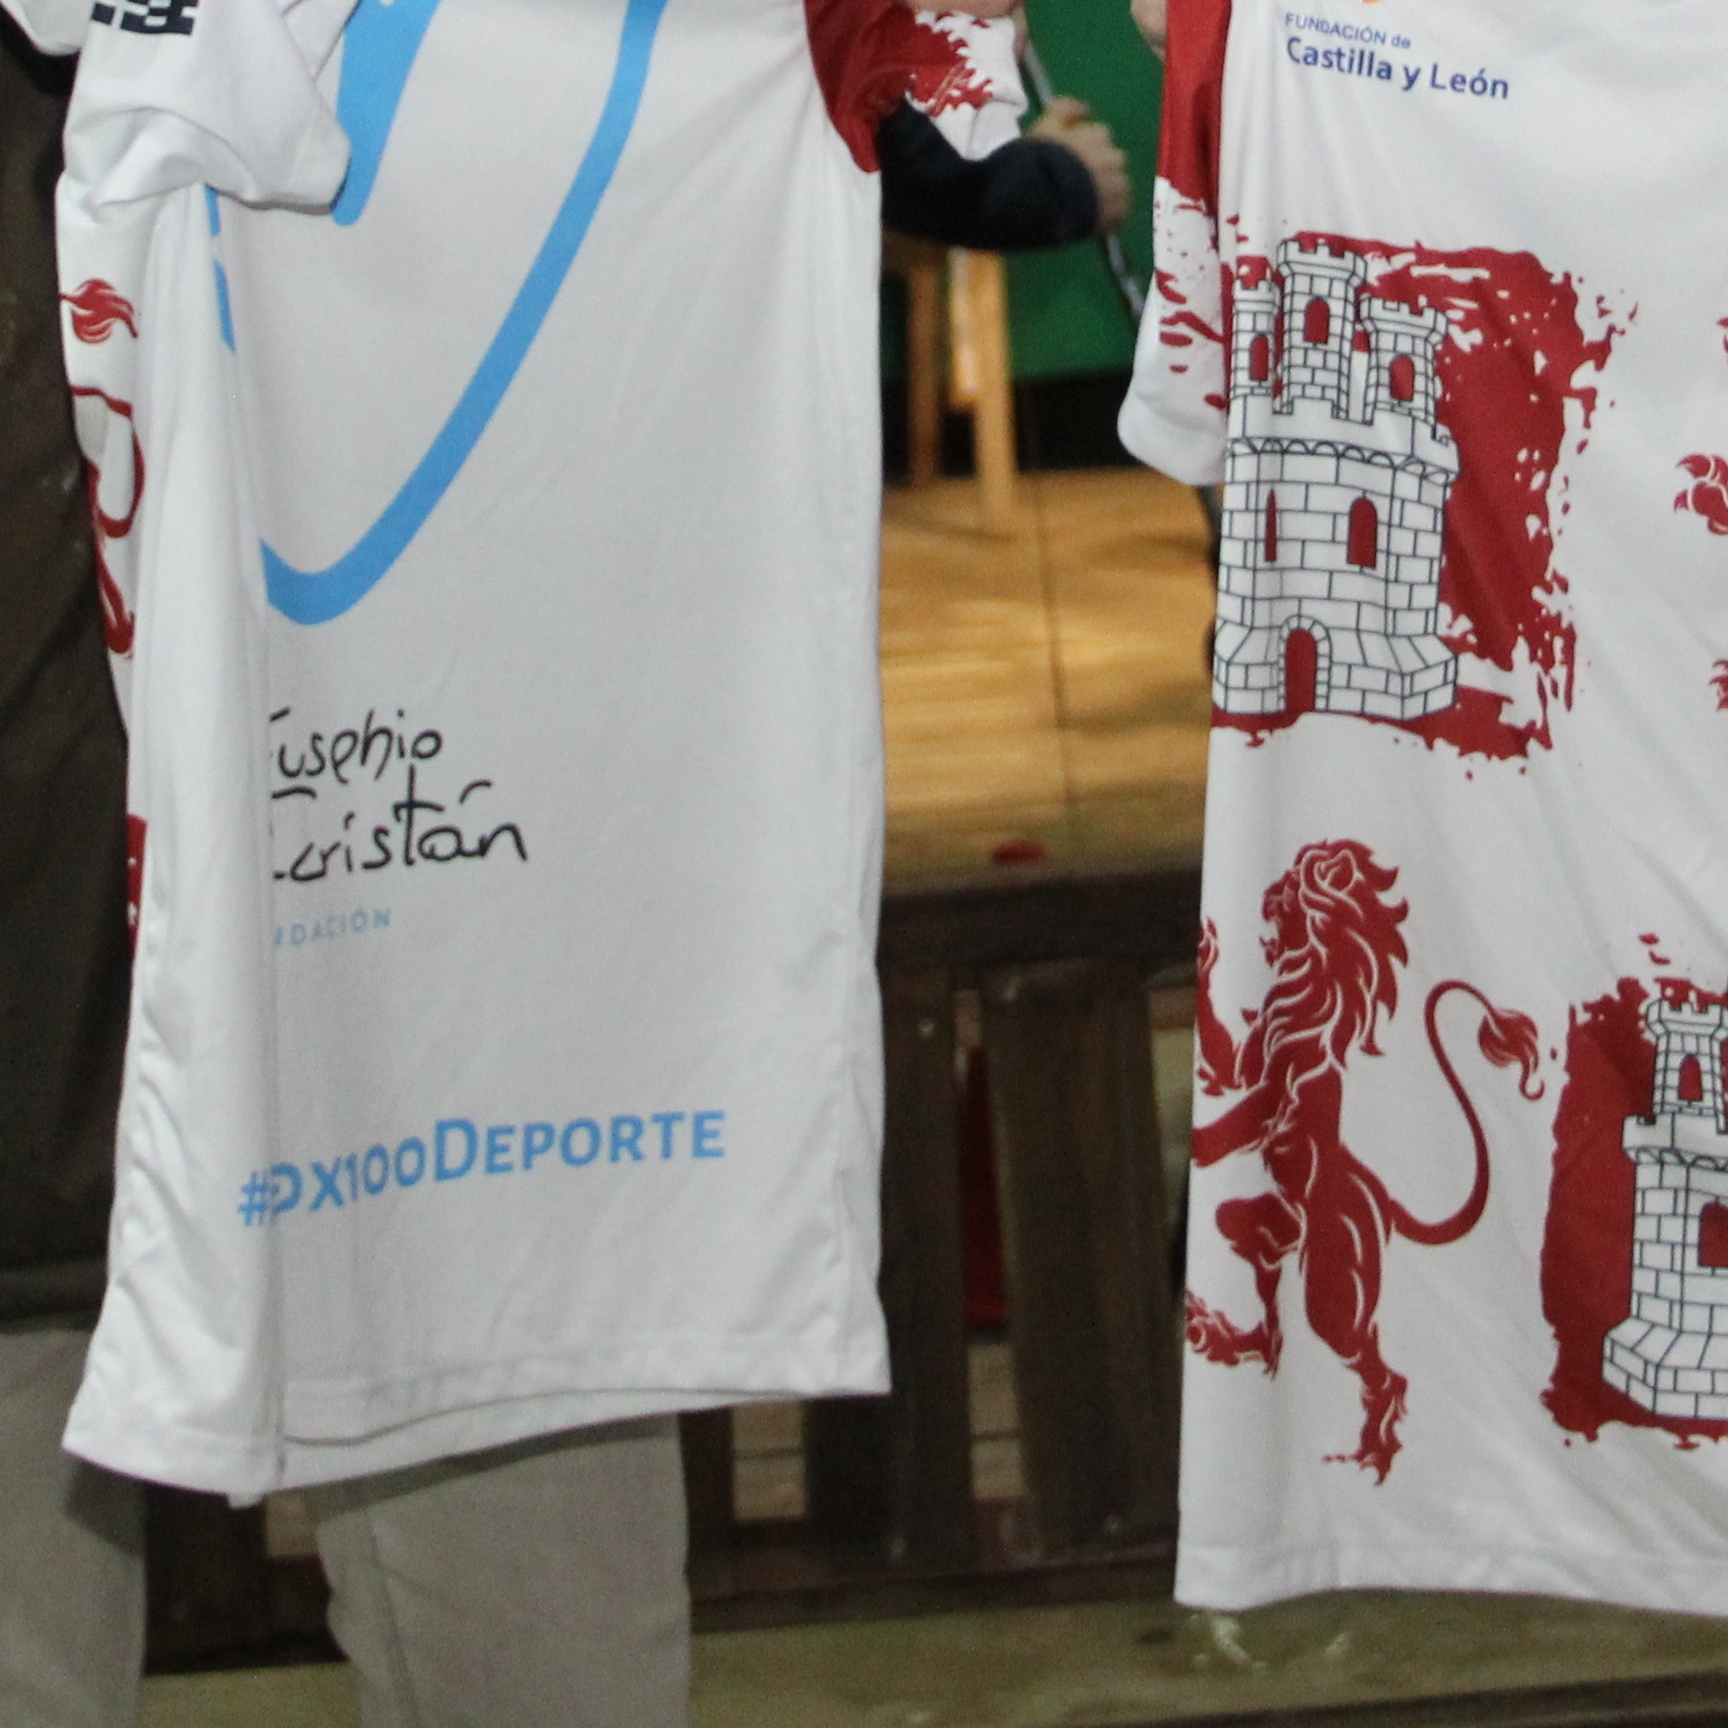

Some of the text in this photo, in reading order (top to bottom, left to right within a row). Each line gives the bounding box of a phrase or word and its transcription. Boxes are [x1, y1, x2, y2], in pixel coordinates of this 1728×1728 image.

[1285, 12, 1412, 50] FUNDACIÓN de
[1286, 36, 1510, 100] Castilla y León
